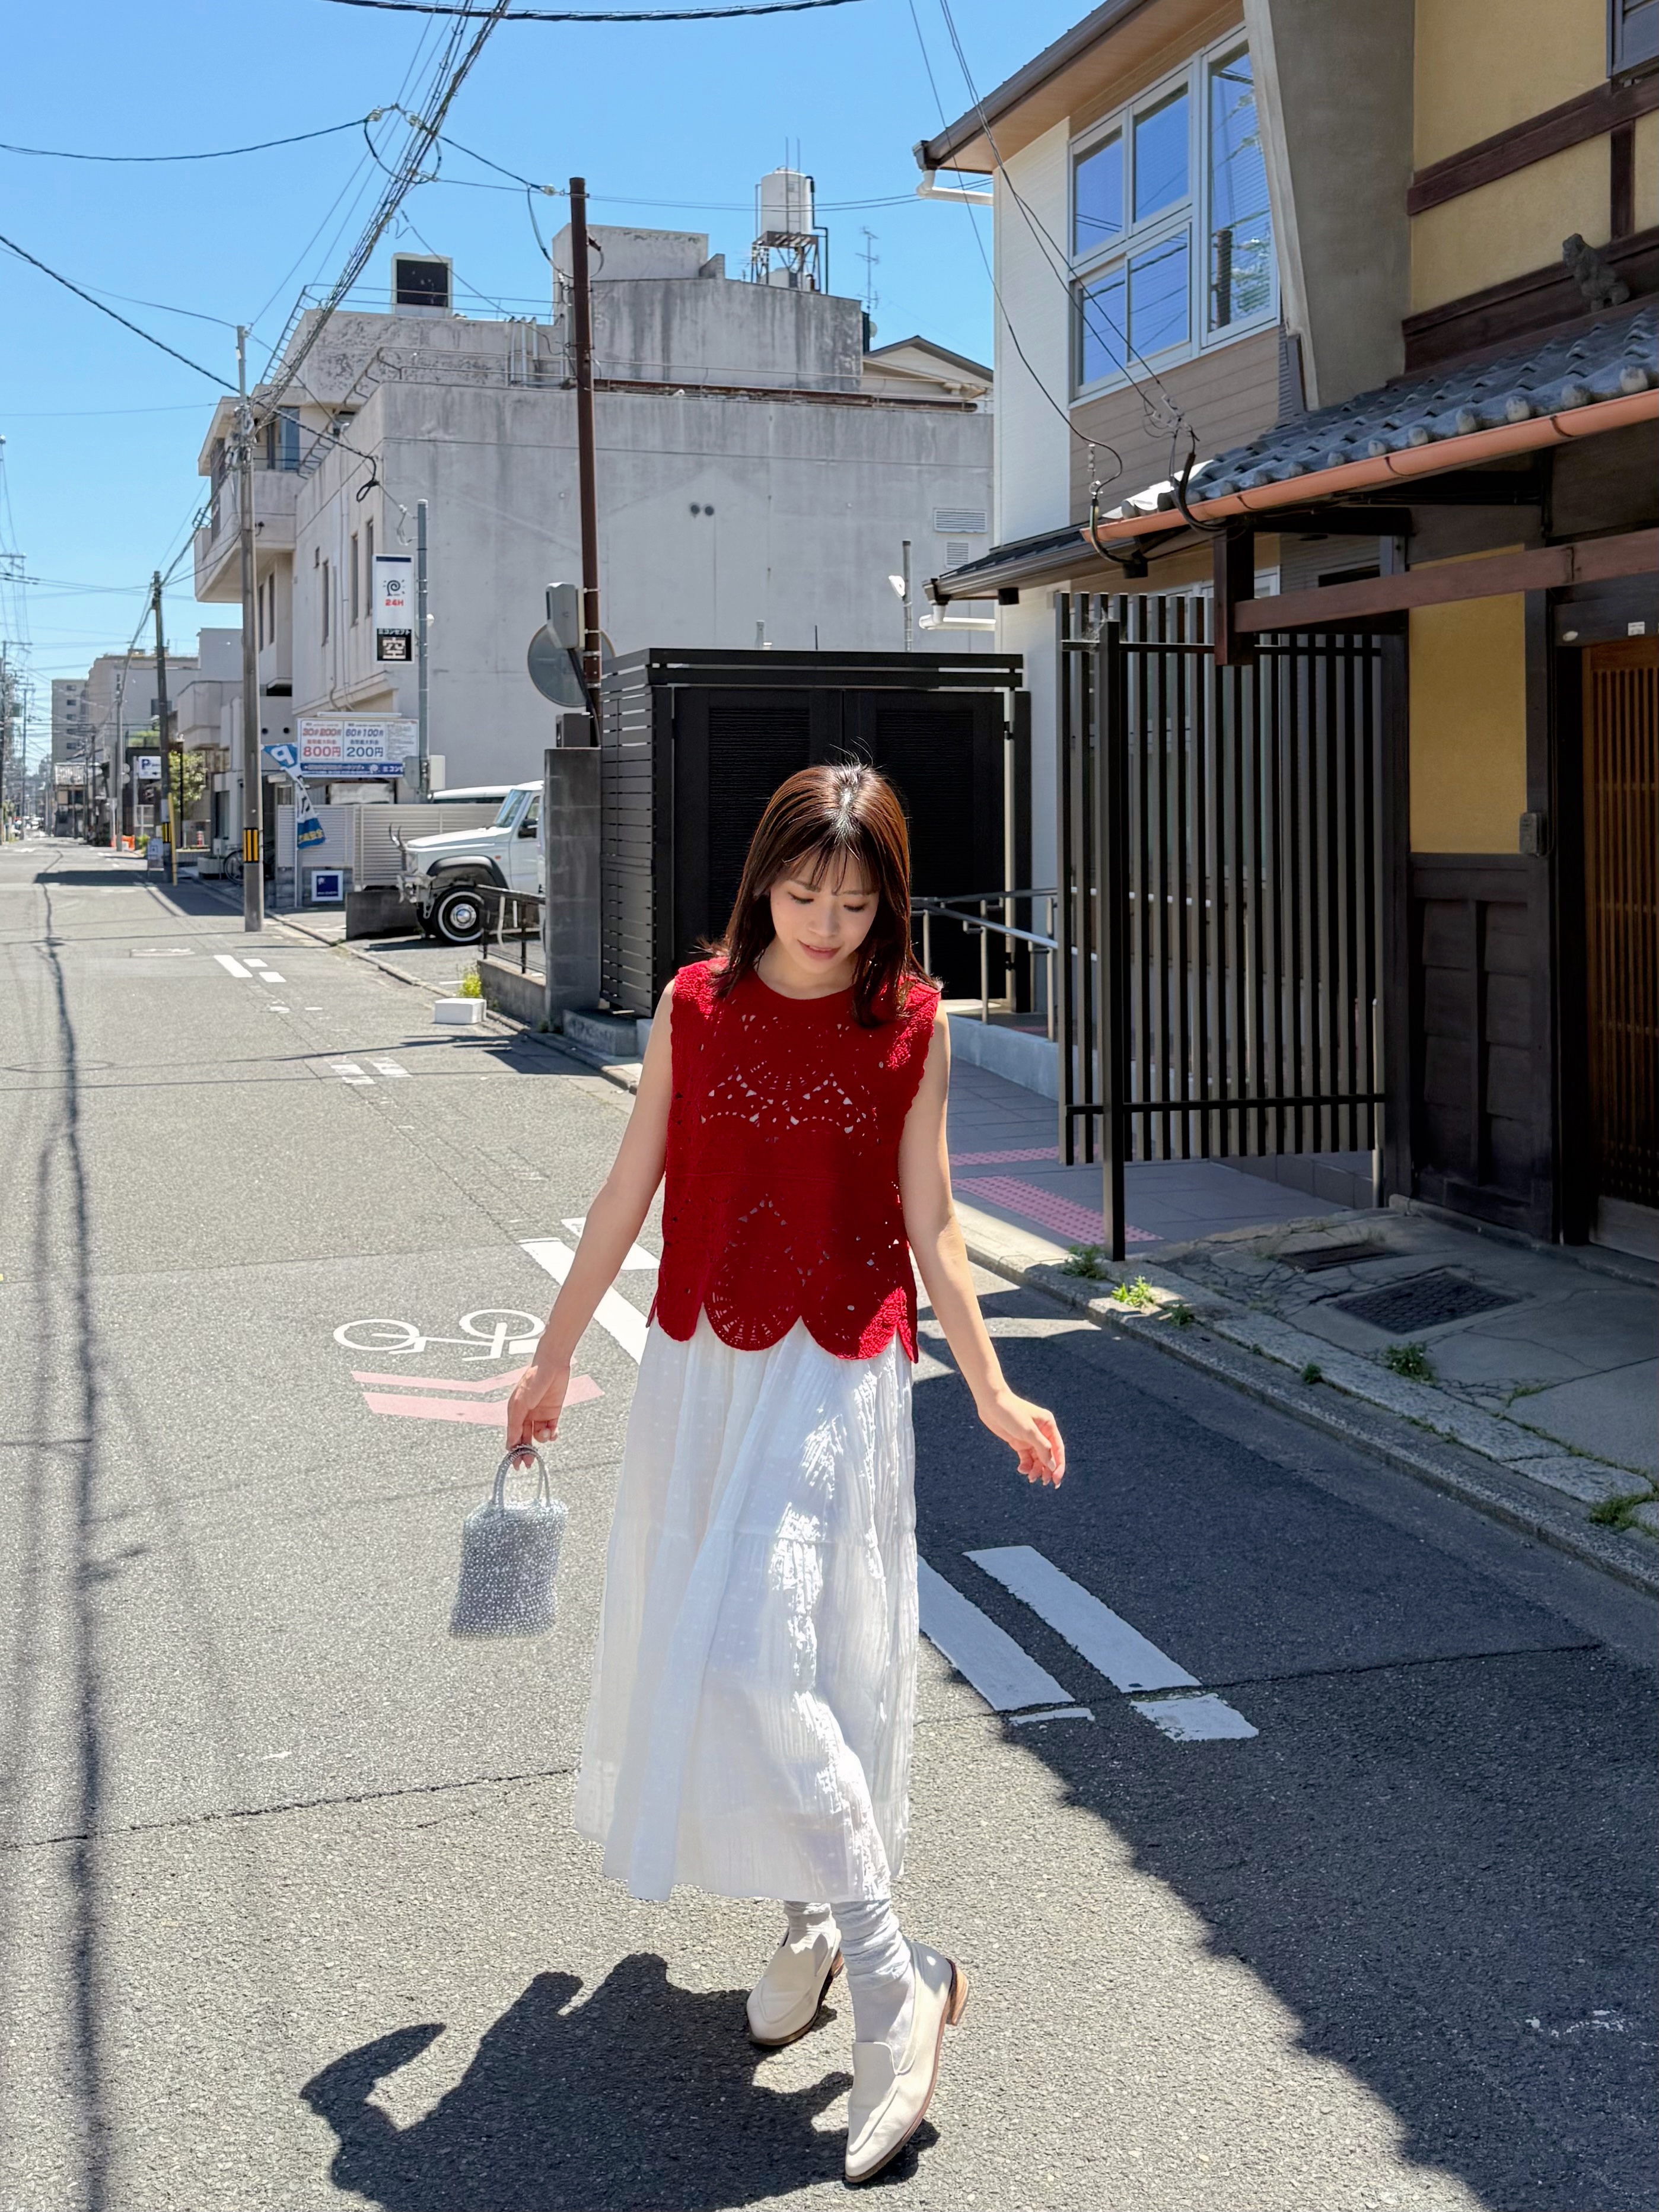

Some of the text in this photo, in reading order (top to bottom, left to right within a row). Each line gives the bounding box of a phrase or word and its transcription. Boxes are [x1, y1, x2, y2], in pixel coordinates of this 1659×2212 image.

[383, 636, 406, 660] 空
[303, 746, 341, 757] 800円
[346, 747, 384, 757] 200円
[142, 759, 151, 770] P
